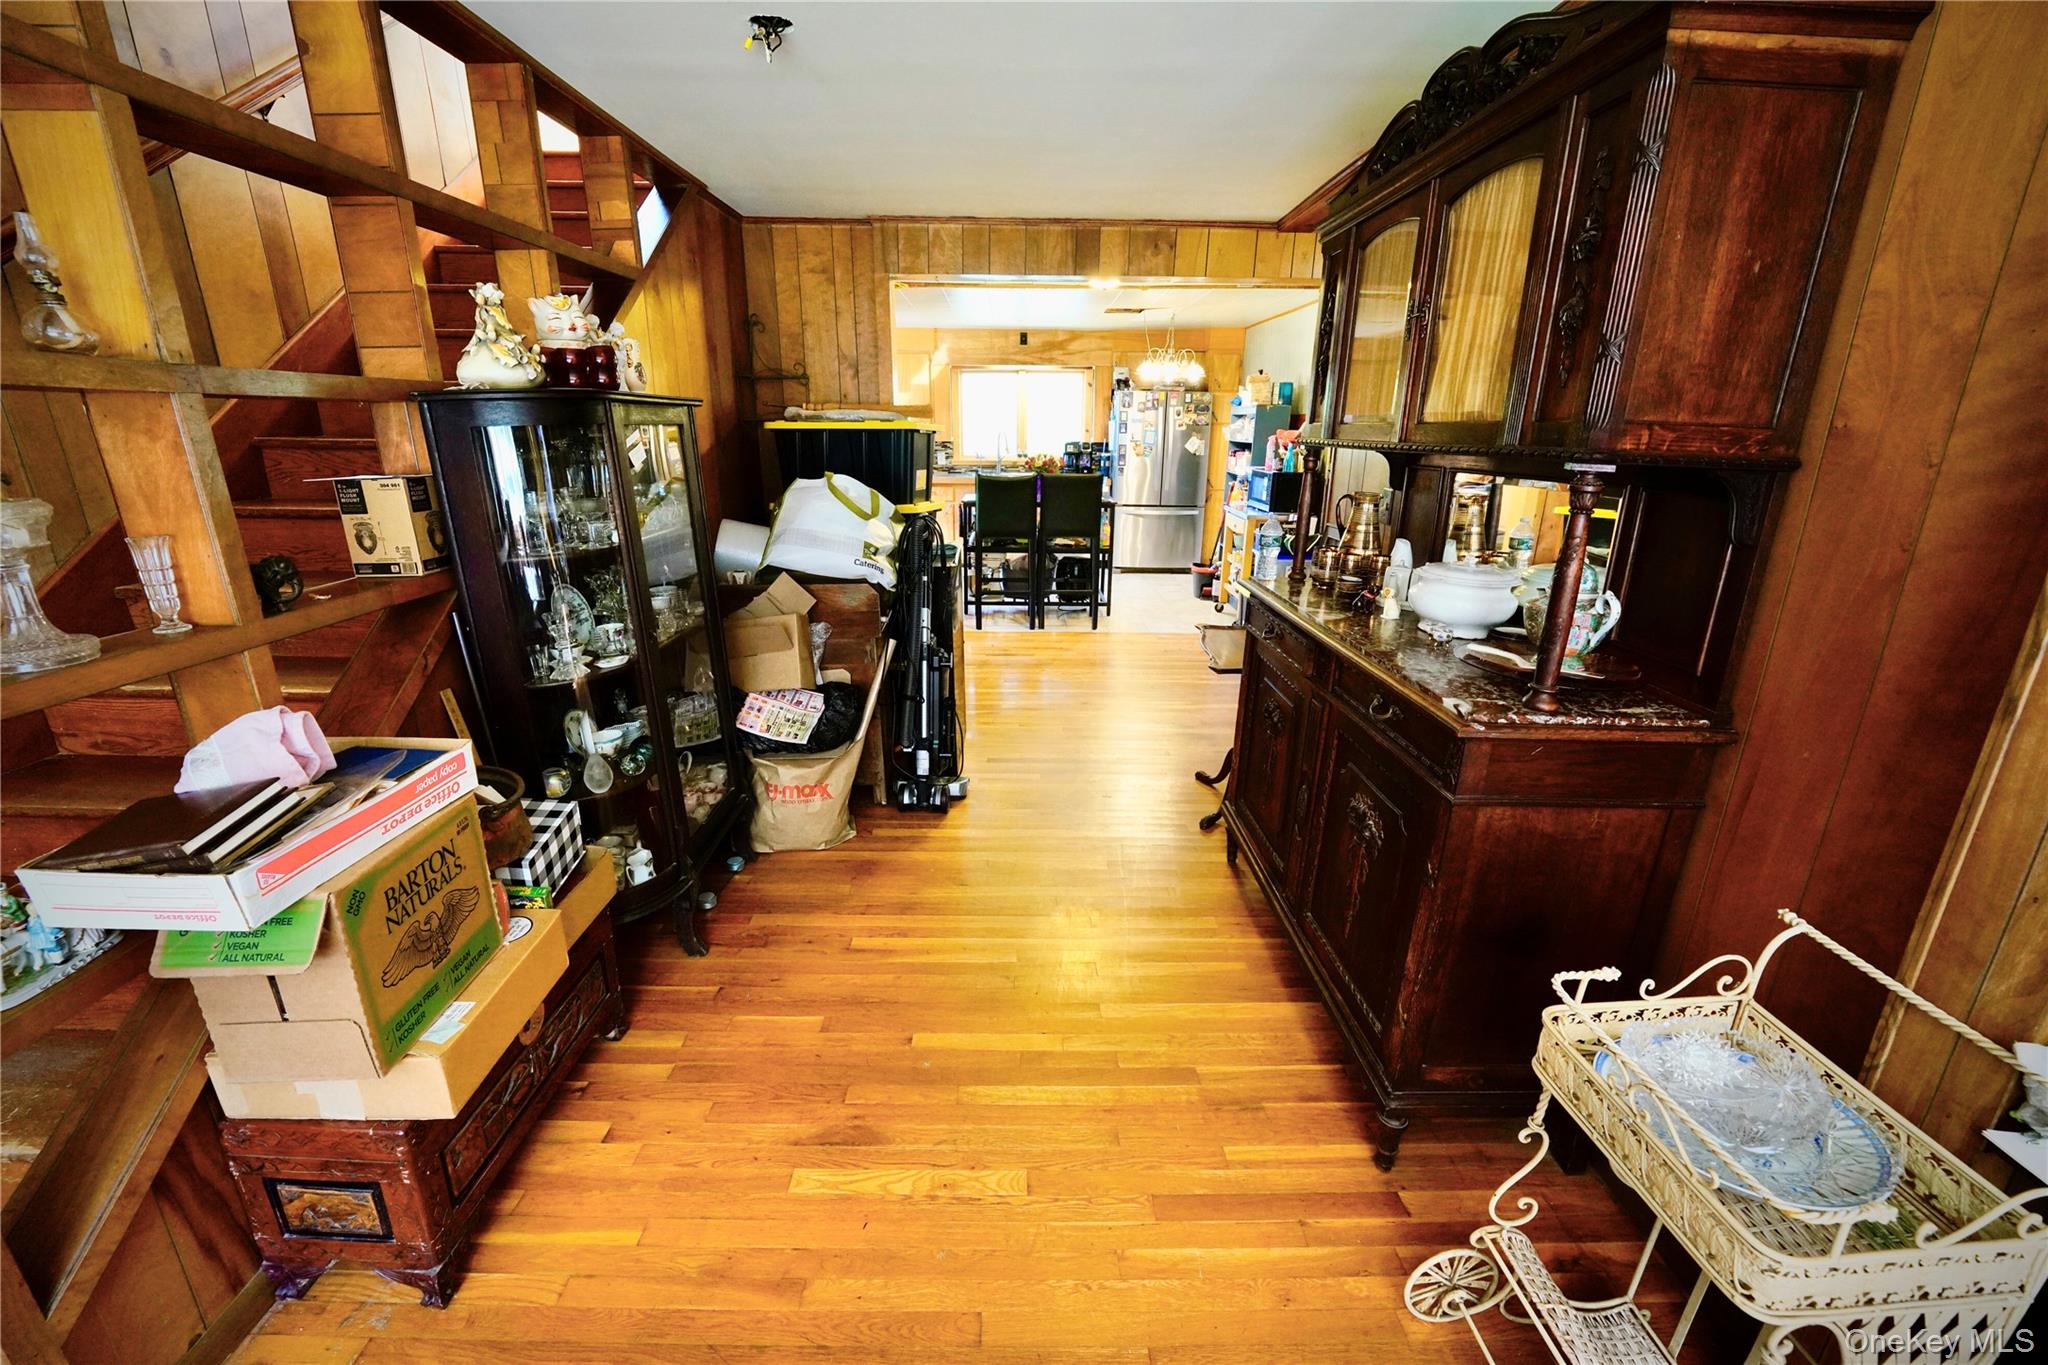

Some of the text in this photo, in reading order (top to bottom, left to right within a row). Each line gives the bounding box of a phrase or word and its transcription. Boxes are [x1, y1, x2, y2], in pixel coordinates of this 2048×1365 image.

[854, 558, 884, 574] Catering
[415, 761, 458, 794] copy paper
[424, 781, 460, 808] Office
[381, 803, 423, 835] DEPOT
[383, 838, 457, 913] BARTON
[346, 889, 361, 915] NON
[352, 891, 366, 917] GMO
[186, 914, 217, 922] Office
[270, 917, 293, 926] FREE
[227, 942, 259, 950] VEGAN
[229, 930, 267, 938] KOSHER
[222, 953, 285, 962] ALL NATURAL
[450, 949, 471, 974] VEGAN
[453, 973, 465, 987] ALL
[464, 944, 490, 972] NATURAL
[394, 982, 440, 1032] GLUTEN FREE
[398, 1011, 427, 1044] KOSHER
